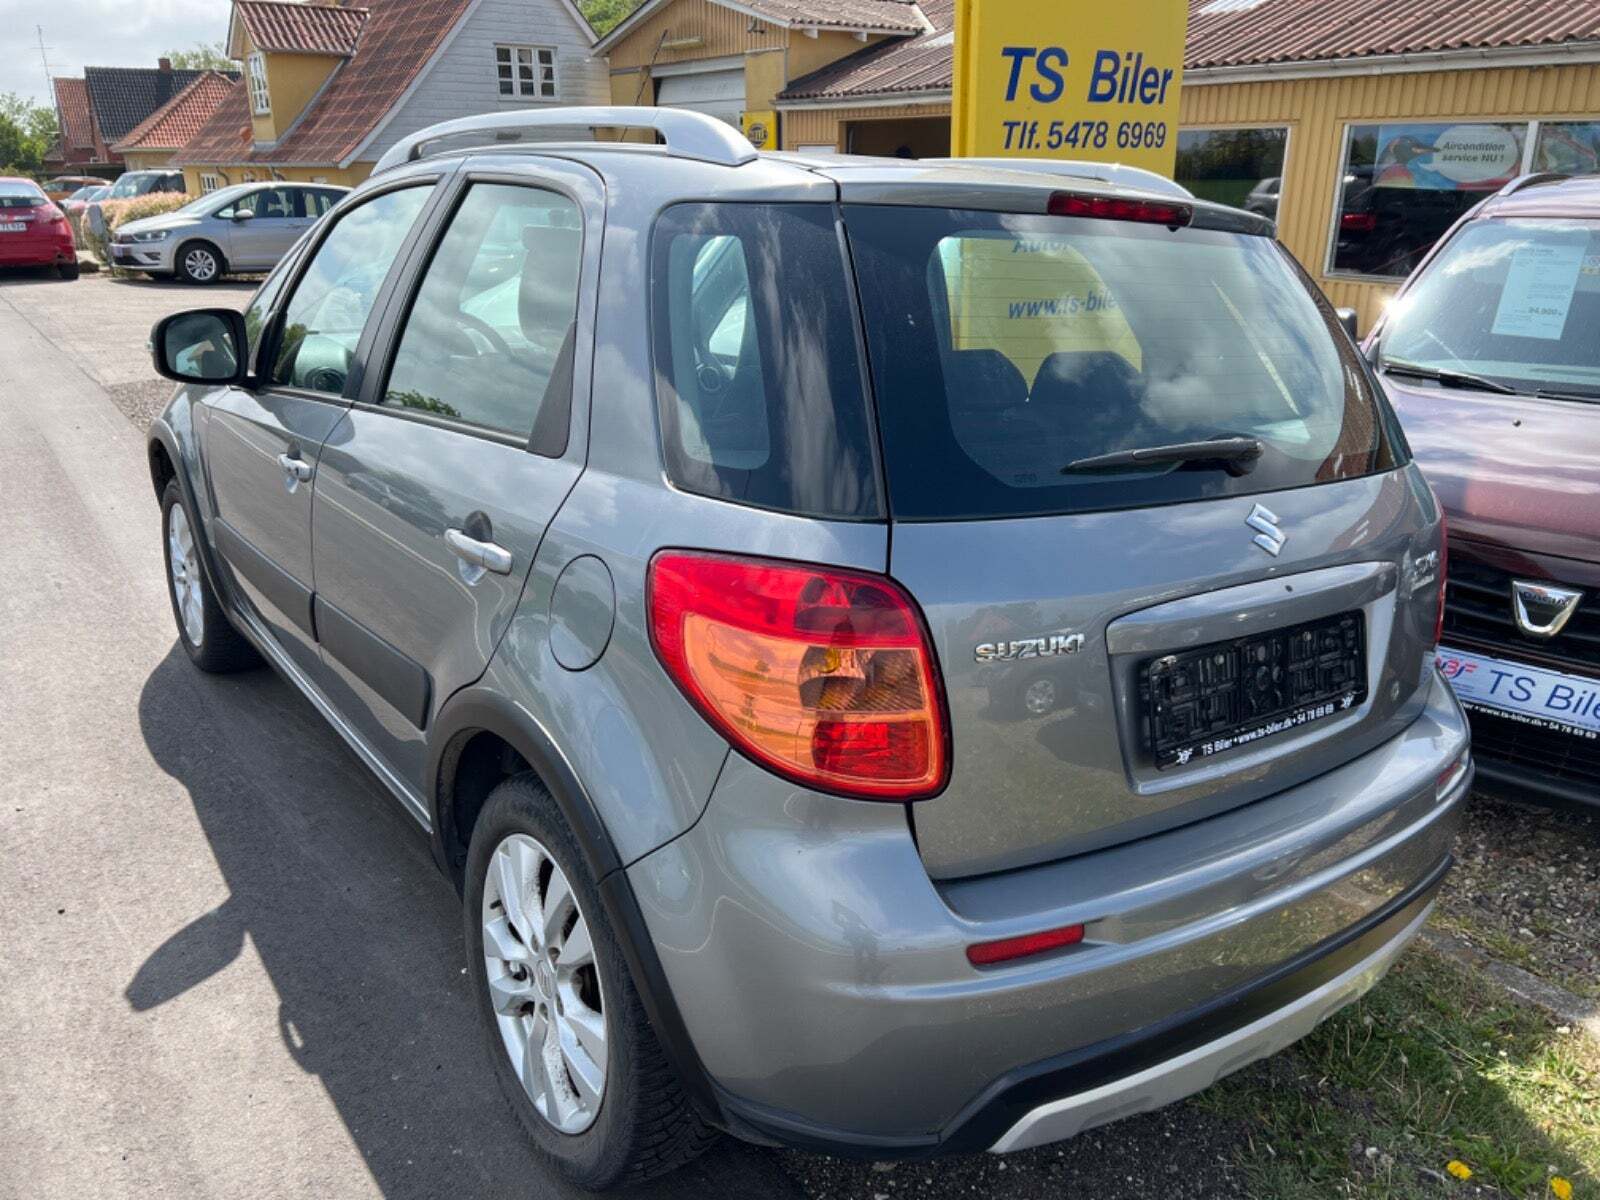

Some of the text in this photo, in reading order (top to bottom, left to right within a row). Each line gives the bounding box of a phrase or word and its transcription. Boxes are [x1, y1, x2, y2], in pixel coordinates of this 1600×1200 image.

[1001, 46, 1173, 105] TS Biler
[1002, 121, 1166, 149] Tlf. 5478 6969
[1443, 141, 1505, 151] Aircondition
[1441, 152, 1478, 162] service
[975, 633, 1085, 663] SUZUKI
[1490, 669, 1536, 702] TS
[1202, 743, 1214, 756] TS
[1214, 737, 1233, 752] Biler
